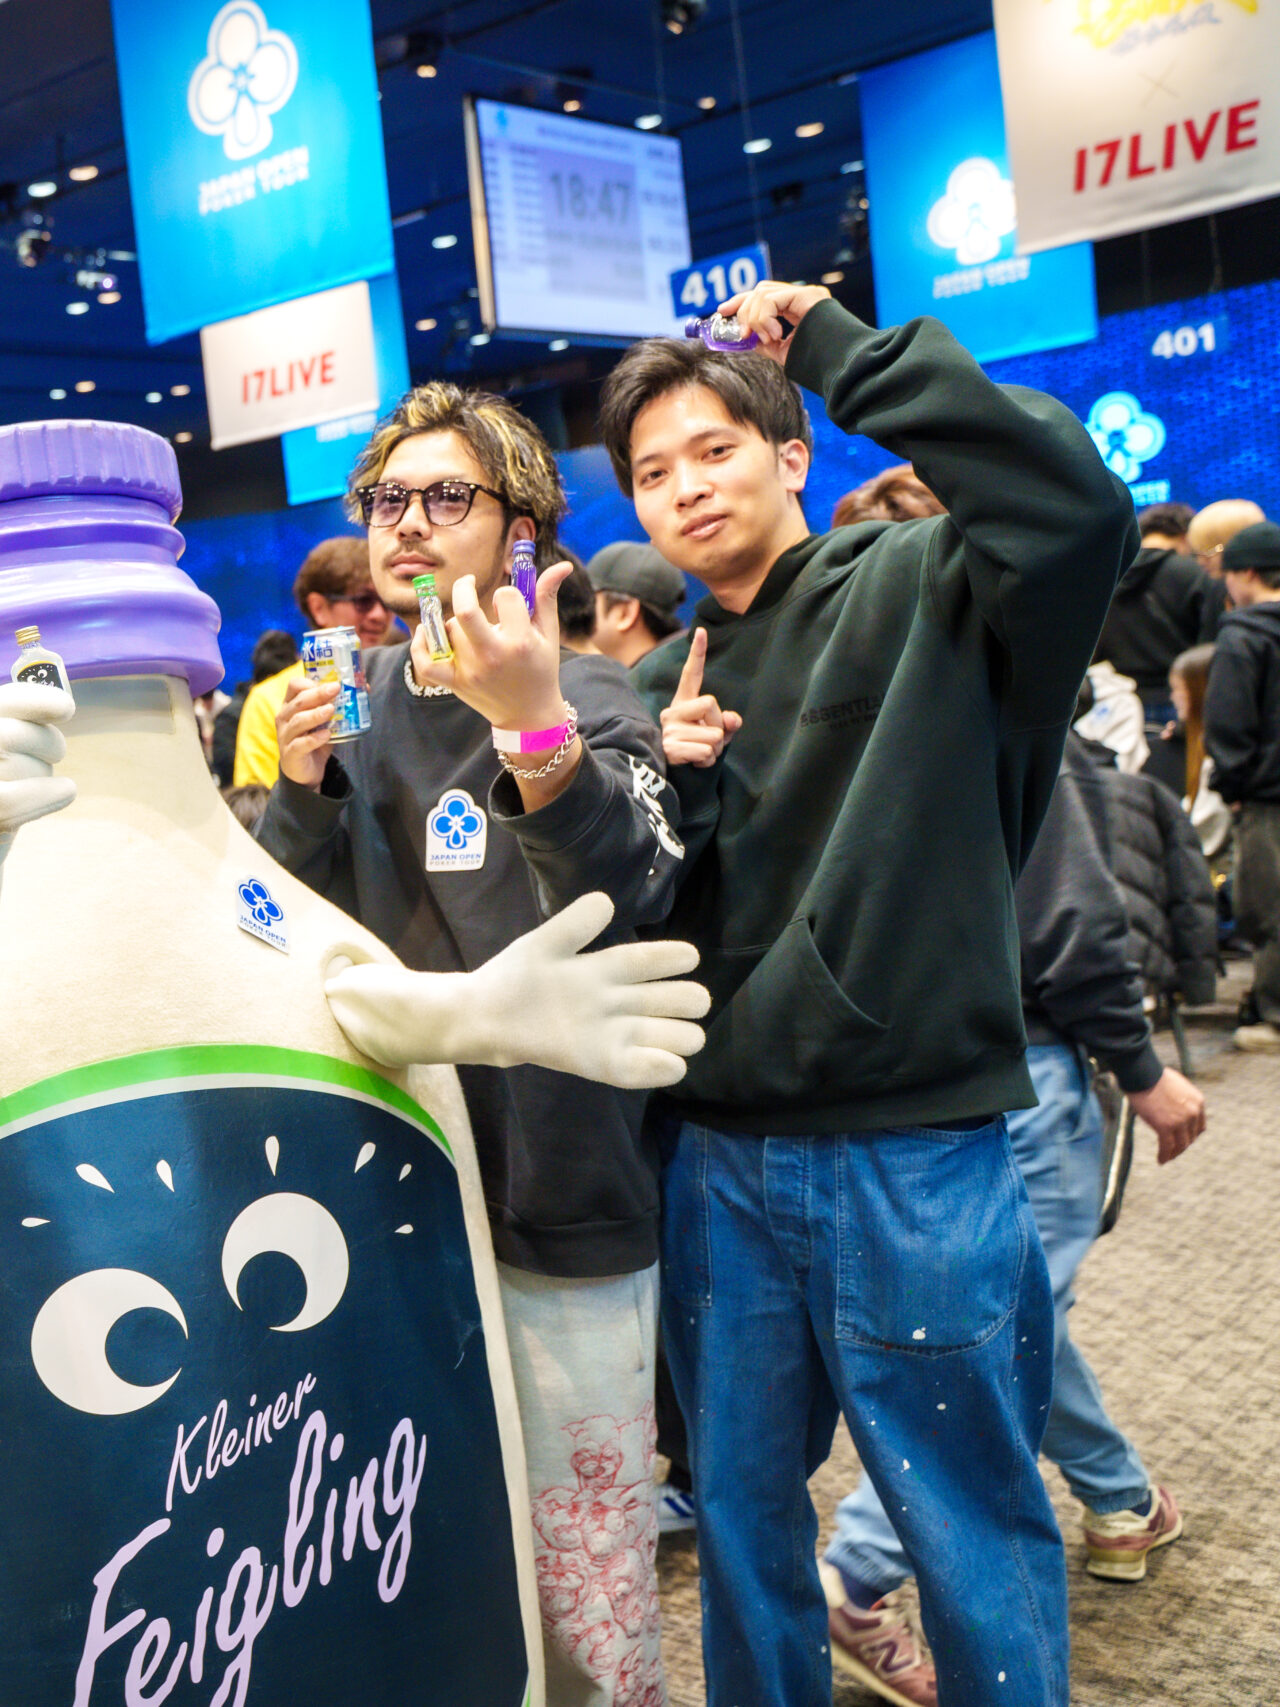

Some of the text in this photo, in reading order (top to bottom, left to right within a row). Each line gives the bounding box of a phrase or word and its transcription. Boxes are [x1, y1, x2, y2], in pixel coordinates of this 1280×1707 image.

[1073, 98, 1260, 194] 17LIVE
[680, 257, 758, 308] 410
[242, 350, 336, 405] 17LIVE
[1151, 321, 1216, 359] 401
[166, 1372, 317, 1512] Kleiner
[72, 1409, 427, 1707] Feigling
